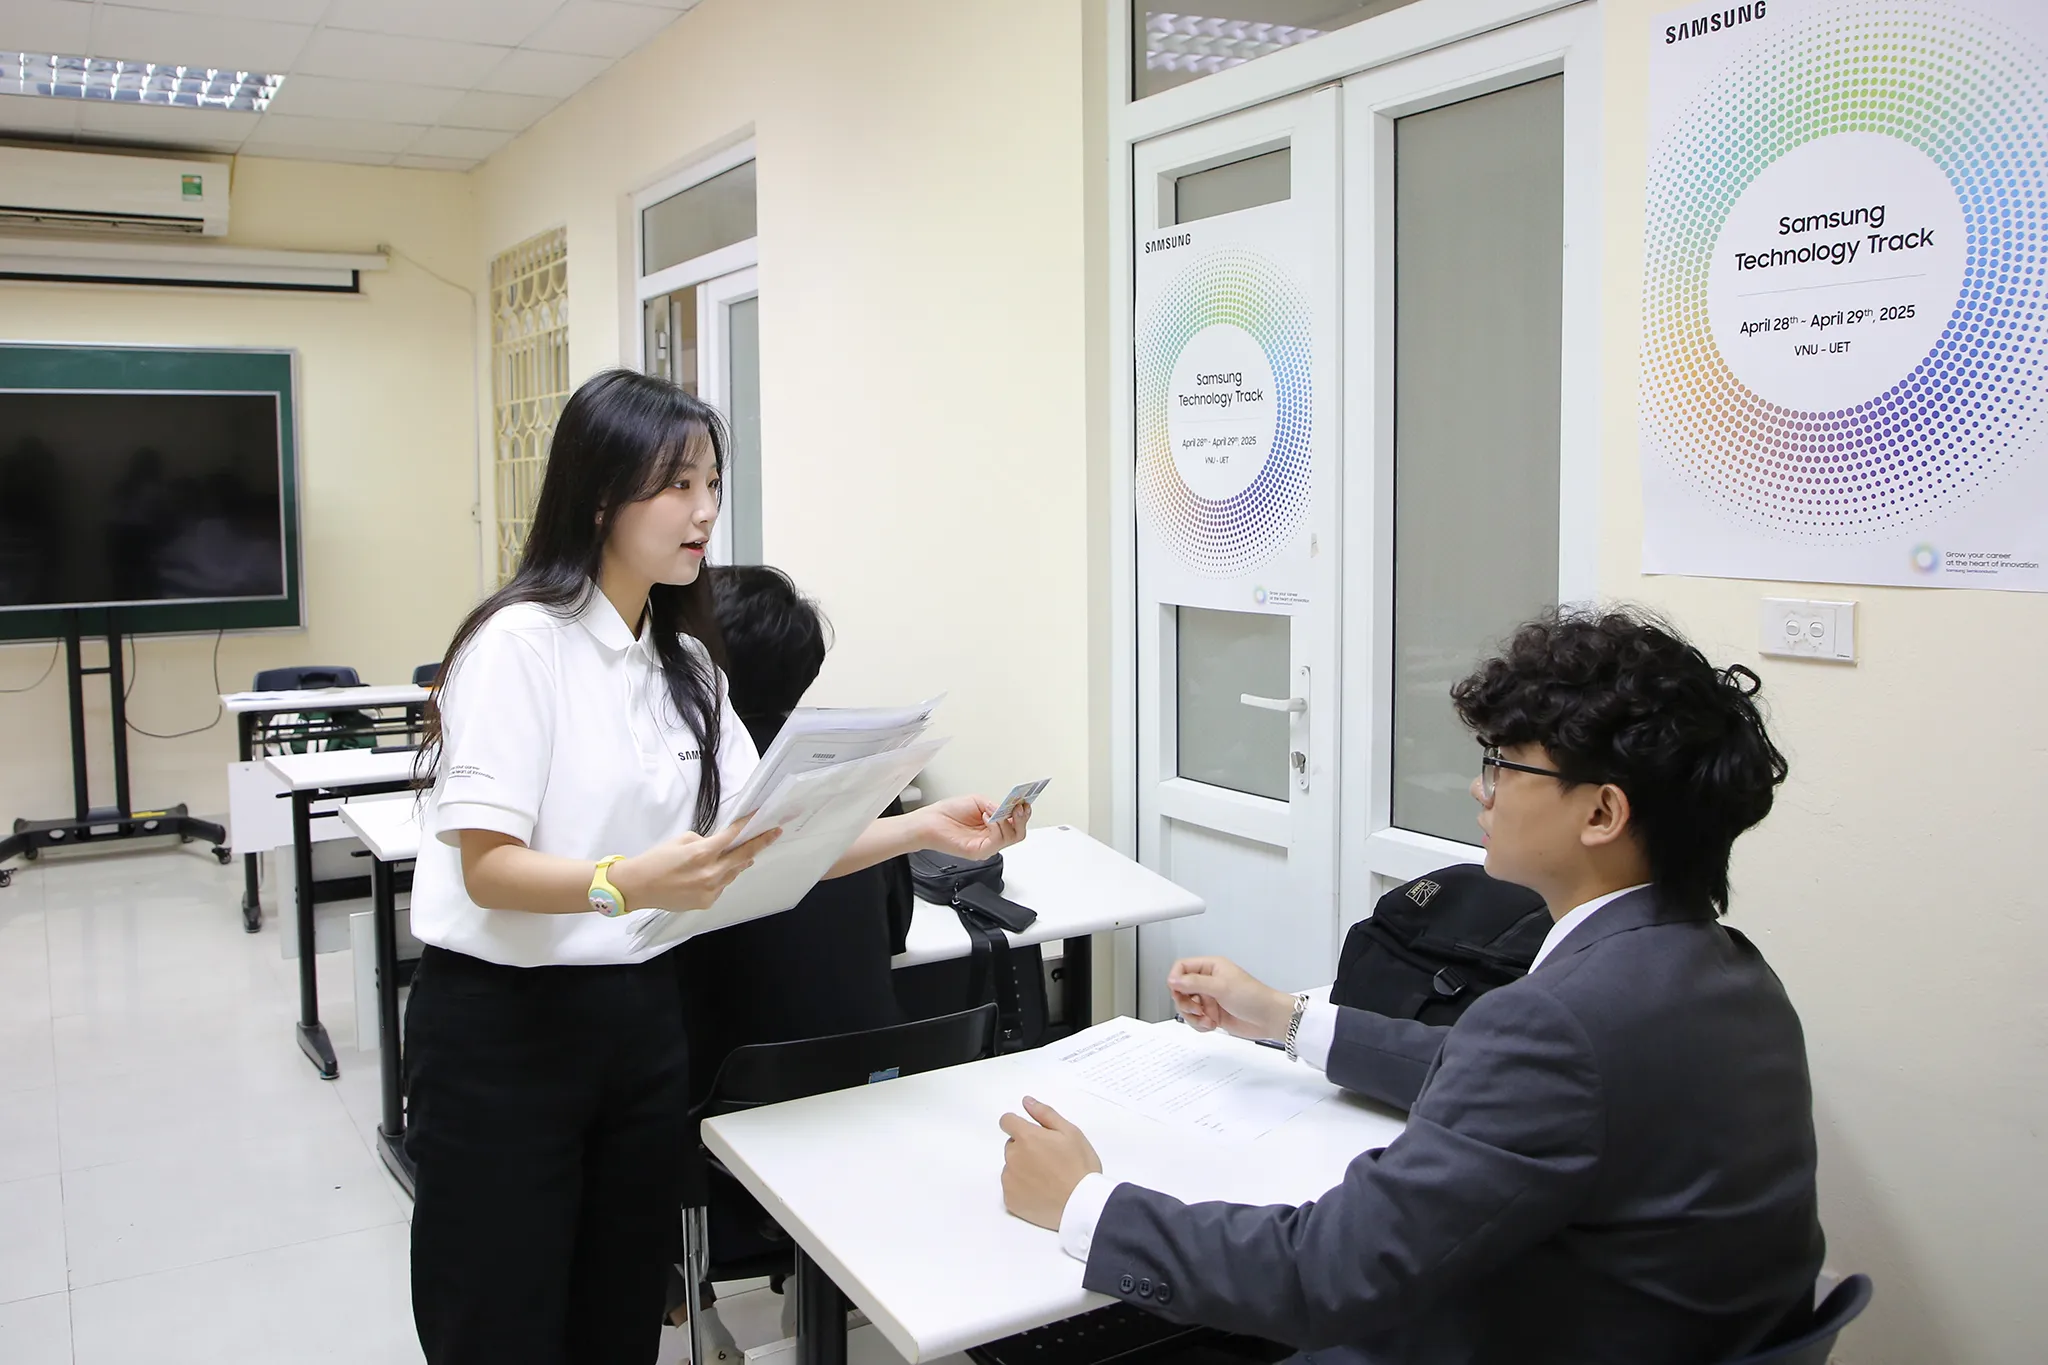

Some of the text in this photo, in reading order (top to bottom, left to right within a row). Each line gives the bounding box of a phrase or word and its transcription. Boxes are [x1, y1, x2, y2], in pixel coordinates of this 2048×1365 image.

[1665, 0, 1767, 44] SAMSUNG
[1778, 205, 1885, 235] Samsung
[1145, 233, 1191, 254] SAMSUNG
[1735, 227, 1934, 271] Technology Track
[1740, 318, 1770, 337] April
[1810, 311, 1843, 331] April
[1879, 304, 1915, 321] 2025
[1794, 344, 1818, 356] VNU
[1829, 341, 1850, 354] UET
[1196, 372, 1242, 387] Samsung
[1178, 388, 1263, 408] Technology Track
[1182, 437, 1195, 450] April
[1212, 436, 1226, 449] April
[1241, 435, 1257, 445] 2025
